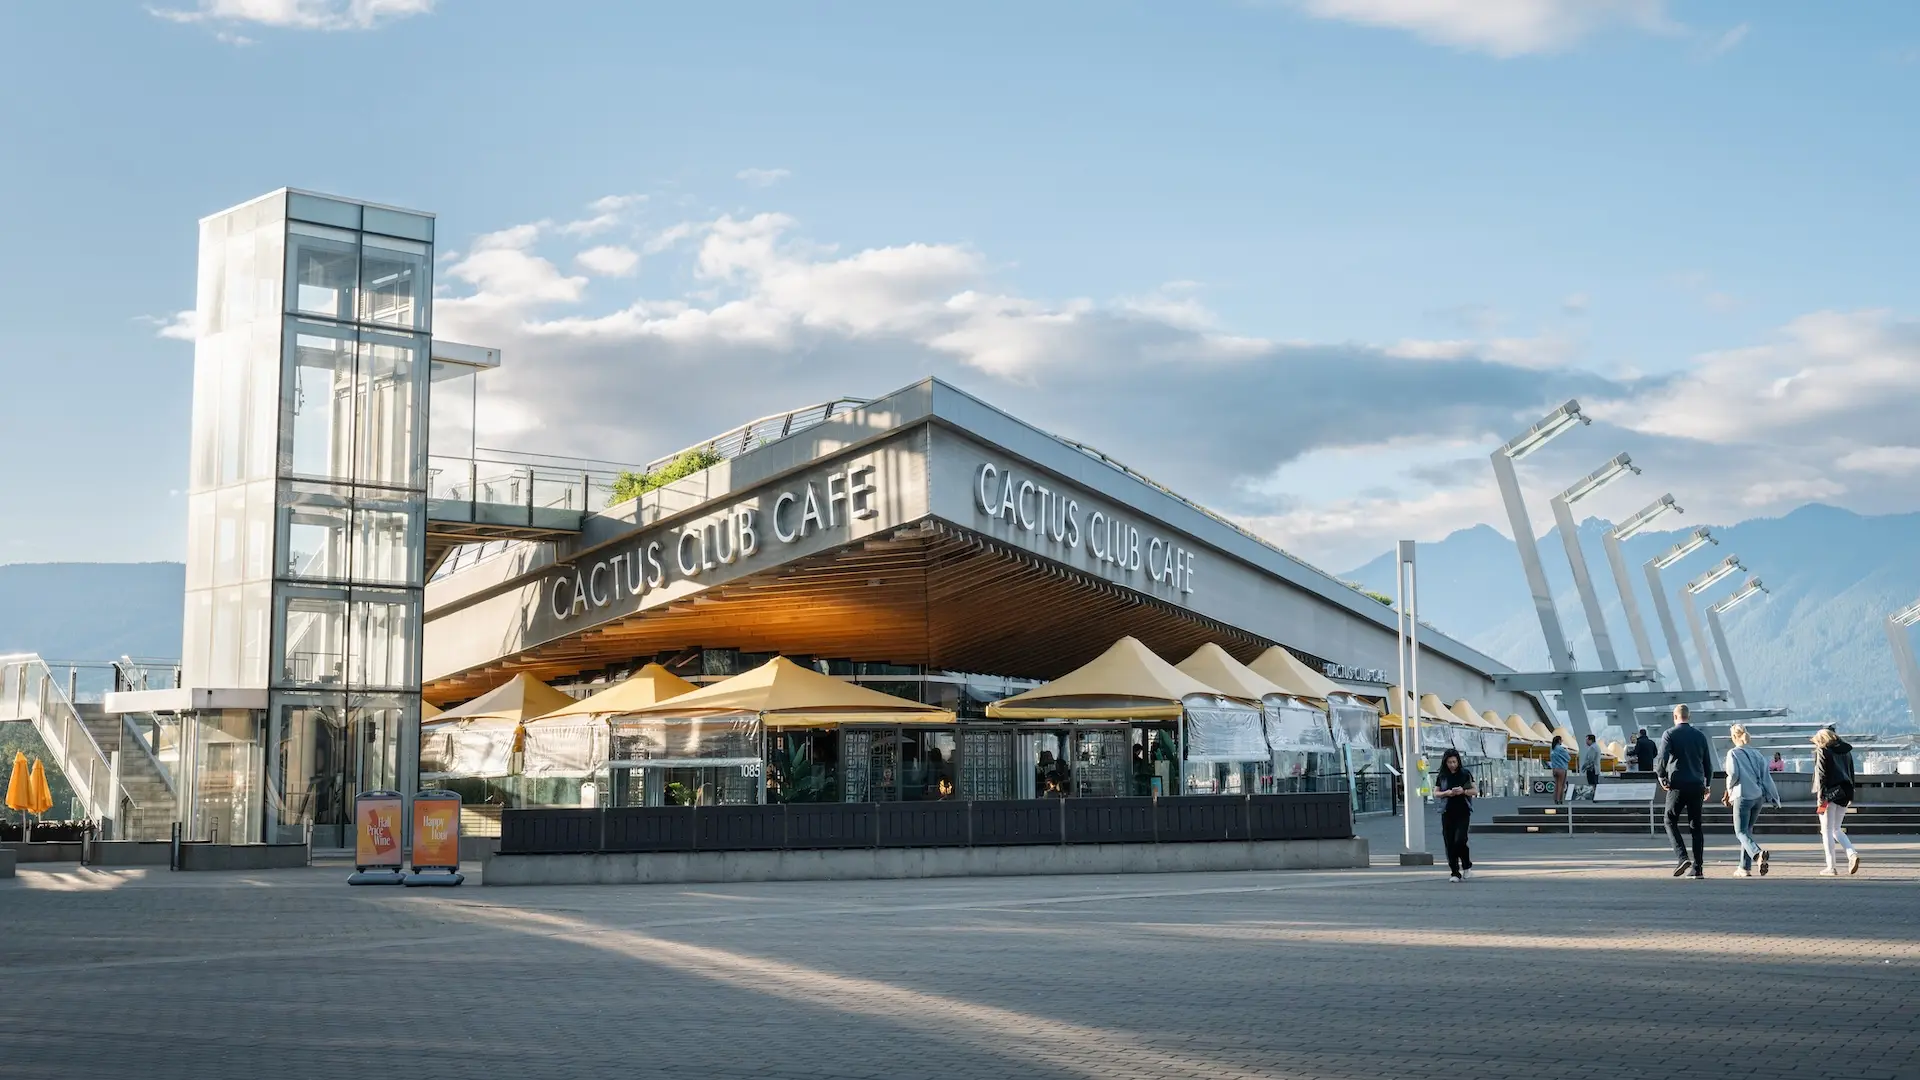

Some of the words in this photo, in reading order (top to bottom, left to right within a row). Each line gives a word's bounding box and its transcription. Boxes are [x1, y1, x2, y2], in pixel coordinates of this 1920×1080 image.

[975, 462, 1079, 549] CACTUS
[1087, 511, 1140, 571] CLUB
[1147, 536, 1195, 594] CAFE
[552, 540, 665, 620] CACTUS
[677, 508, 758, 576] CLUB
[773, 465, 877, 543] CAFE
[1327, 663, 1353, 680] CACTUS
[1355, 666, 1371, 682] CLUB
[1373, 668, 1388, 683] CAFE
[741, 764, 760, 777] 1085
[378, 816, 392, 828] Half
[423, 815, 445, 830] Happy
[367, 825, 384, 836] Price
[431, 827, 448, 840] Hour
[374, 835, 391, 846] Wine
